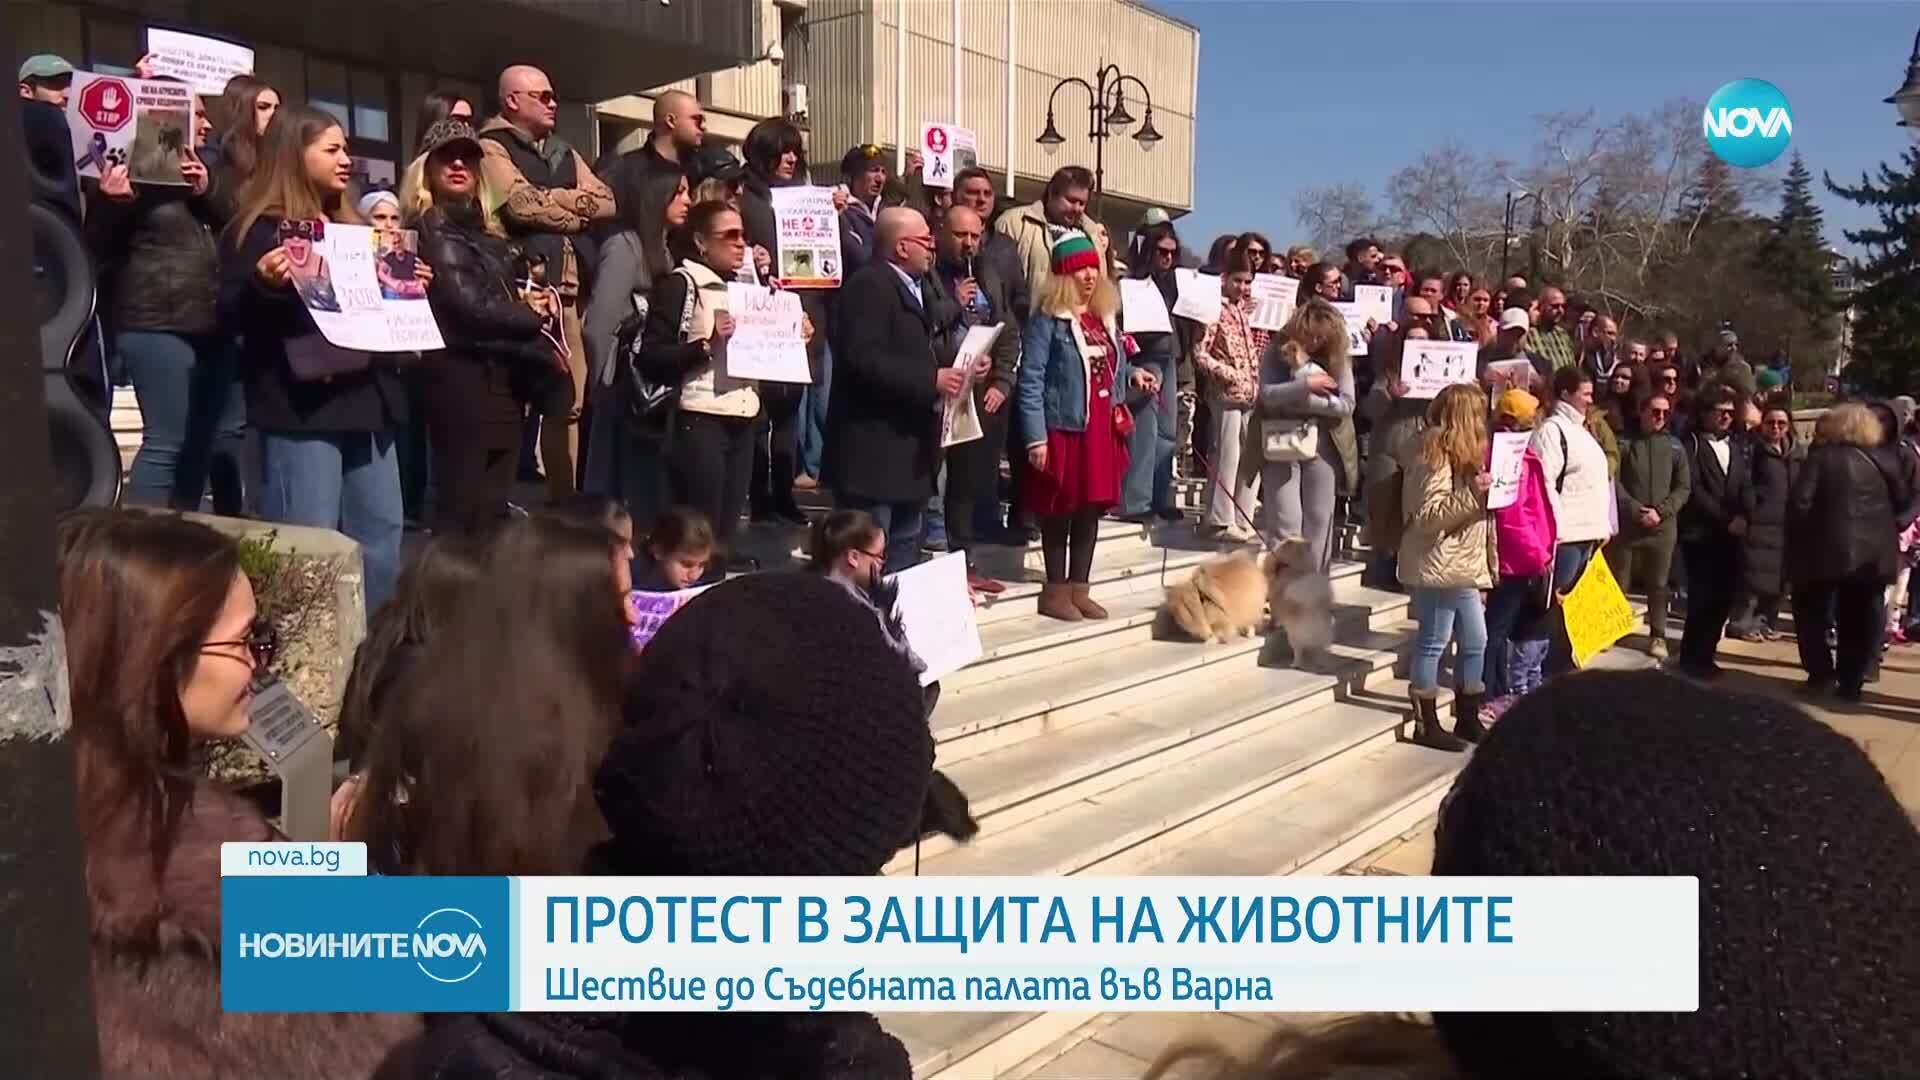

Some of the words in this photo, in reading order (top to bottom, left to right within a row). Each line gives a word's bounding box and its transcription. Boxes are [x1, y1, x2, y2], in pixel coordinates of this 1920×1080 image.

[95, 111, 121, 124] STOP
[782, 218, 799, 230] НЕ
[782, 230, 793, 238] НА
